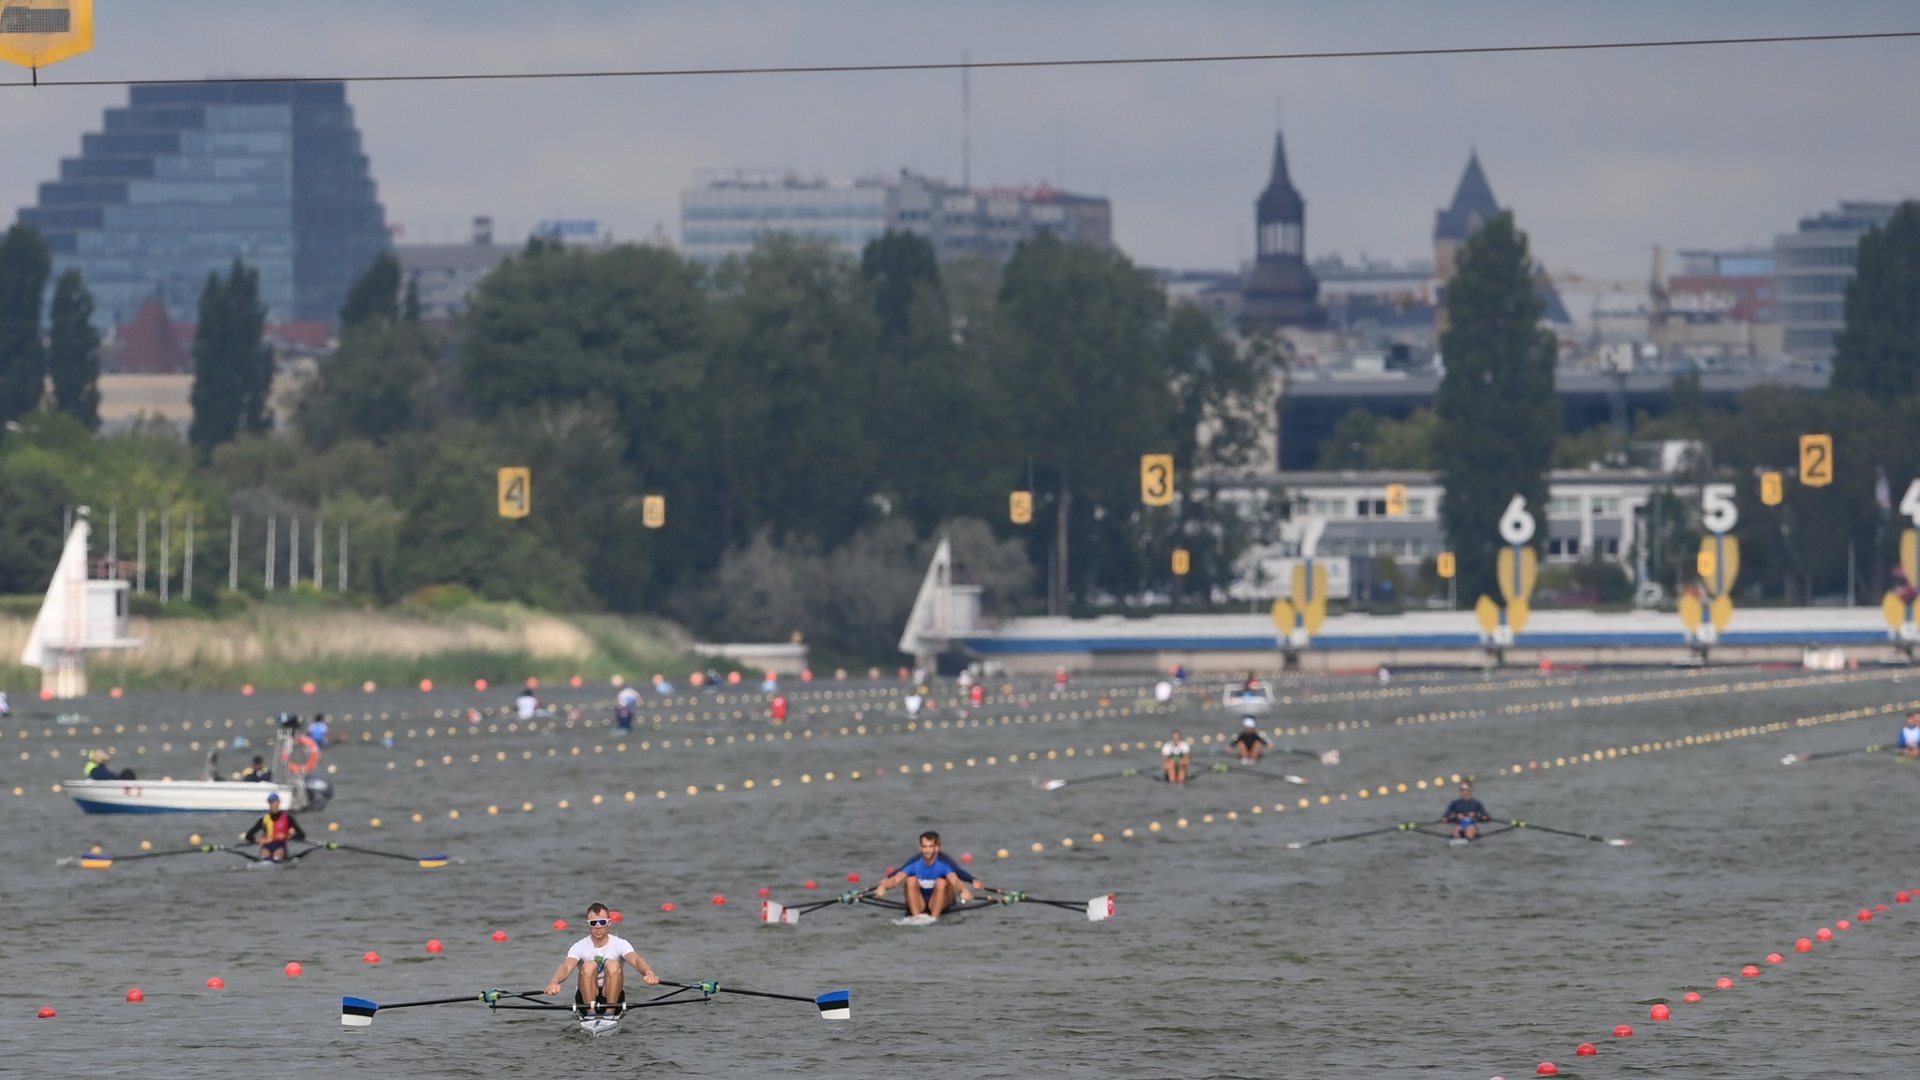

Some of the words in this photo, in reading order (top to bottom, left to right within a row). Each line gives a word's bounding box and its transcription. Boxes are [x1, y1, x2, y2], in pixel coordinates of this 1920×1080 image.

[1806, 444, 1826, 477] 2
[504, 476, 524, 511] 4
[1148, 463, 1167, 497] 3
[1499, 493, 1536, 544] 6
[1702, 483, 1737, 532] 5
